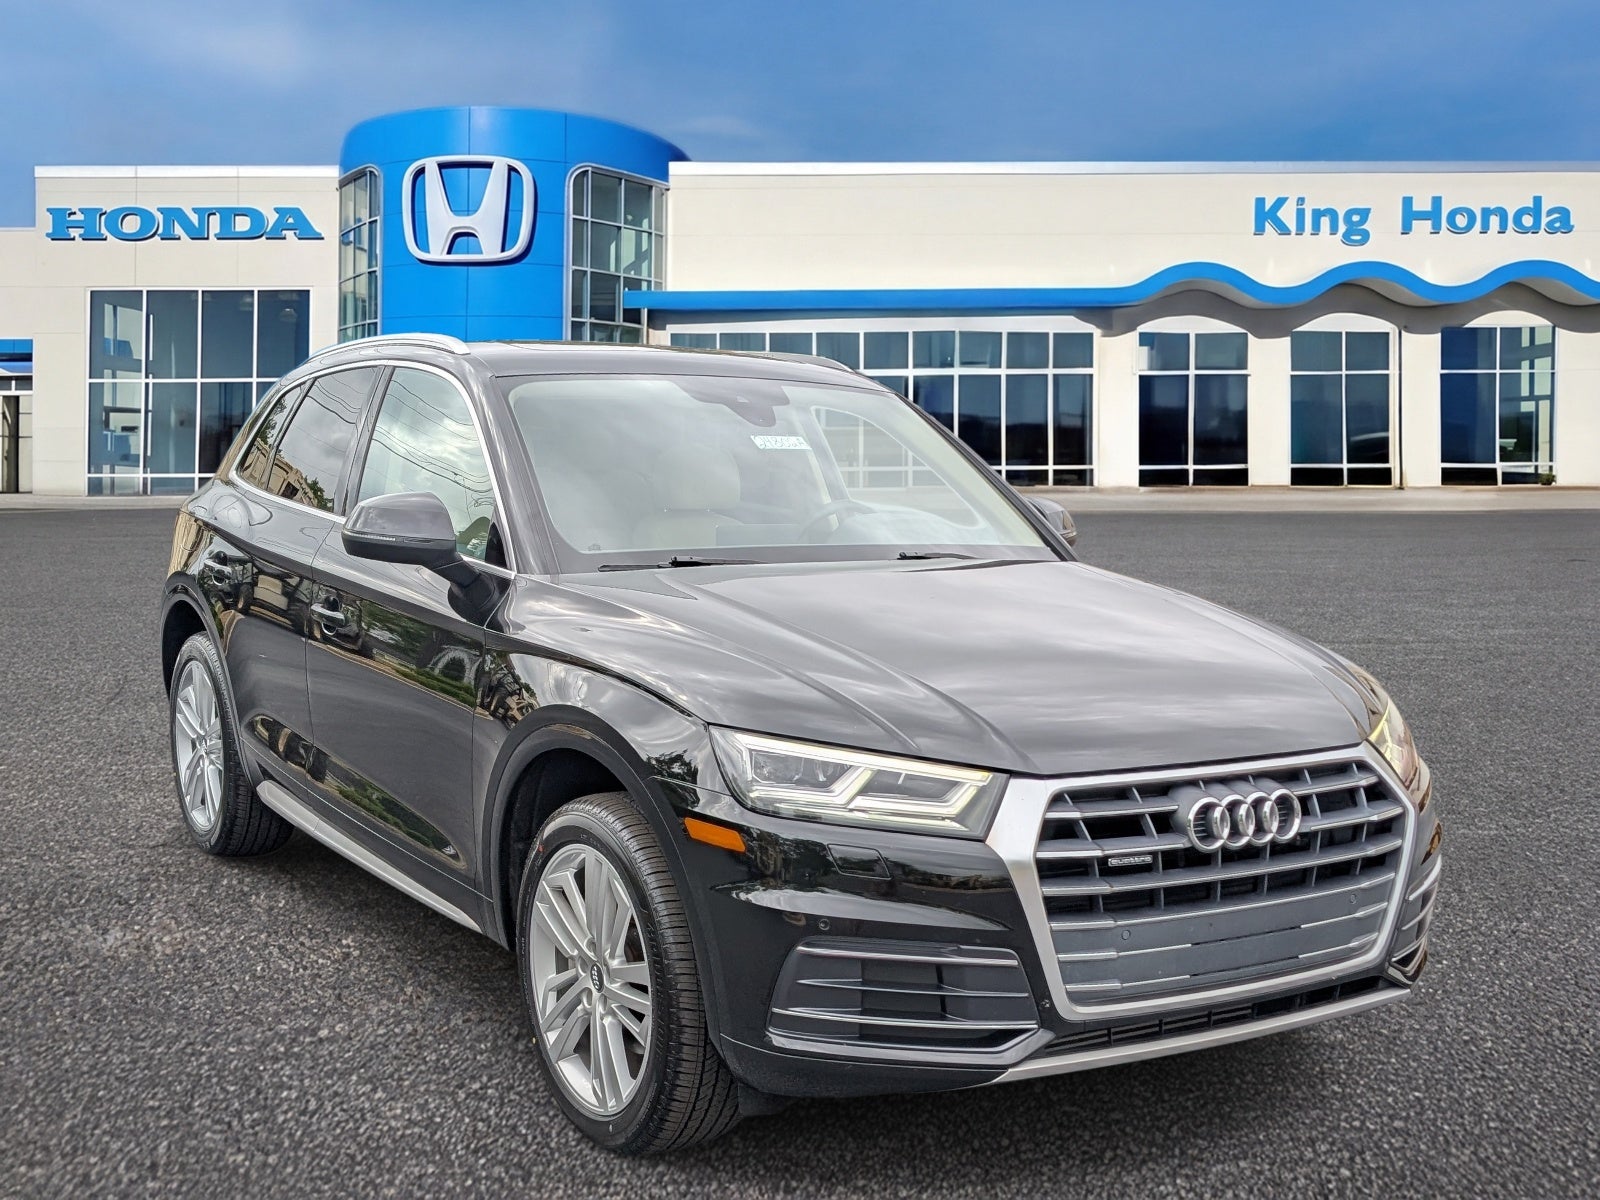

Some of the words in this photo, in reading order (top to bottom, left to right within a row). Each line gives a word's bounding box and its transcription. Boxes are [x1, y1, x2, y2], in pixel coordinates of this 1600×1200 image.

[46, 206, 323, 241] HONDA
[1253, 196, 1372, 246] King
[1400, 195, 1574, 235] Honda
